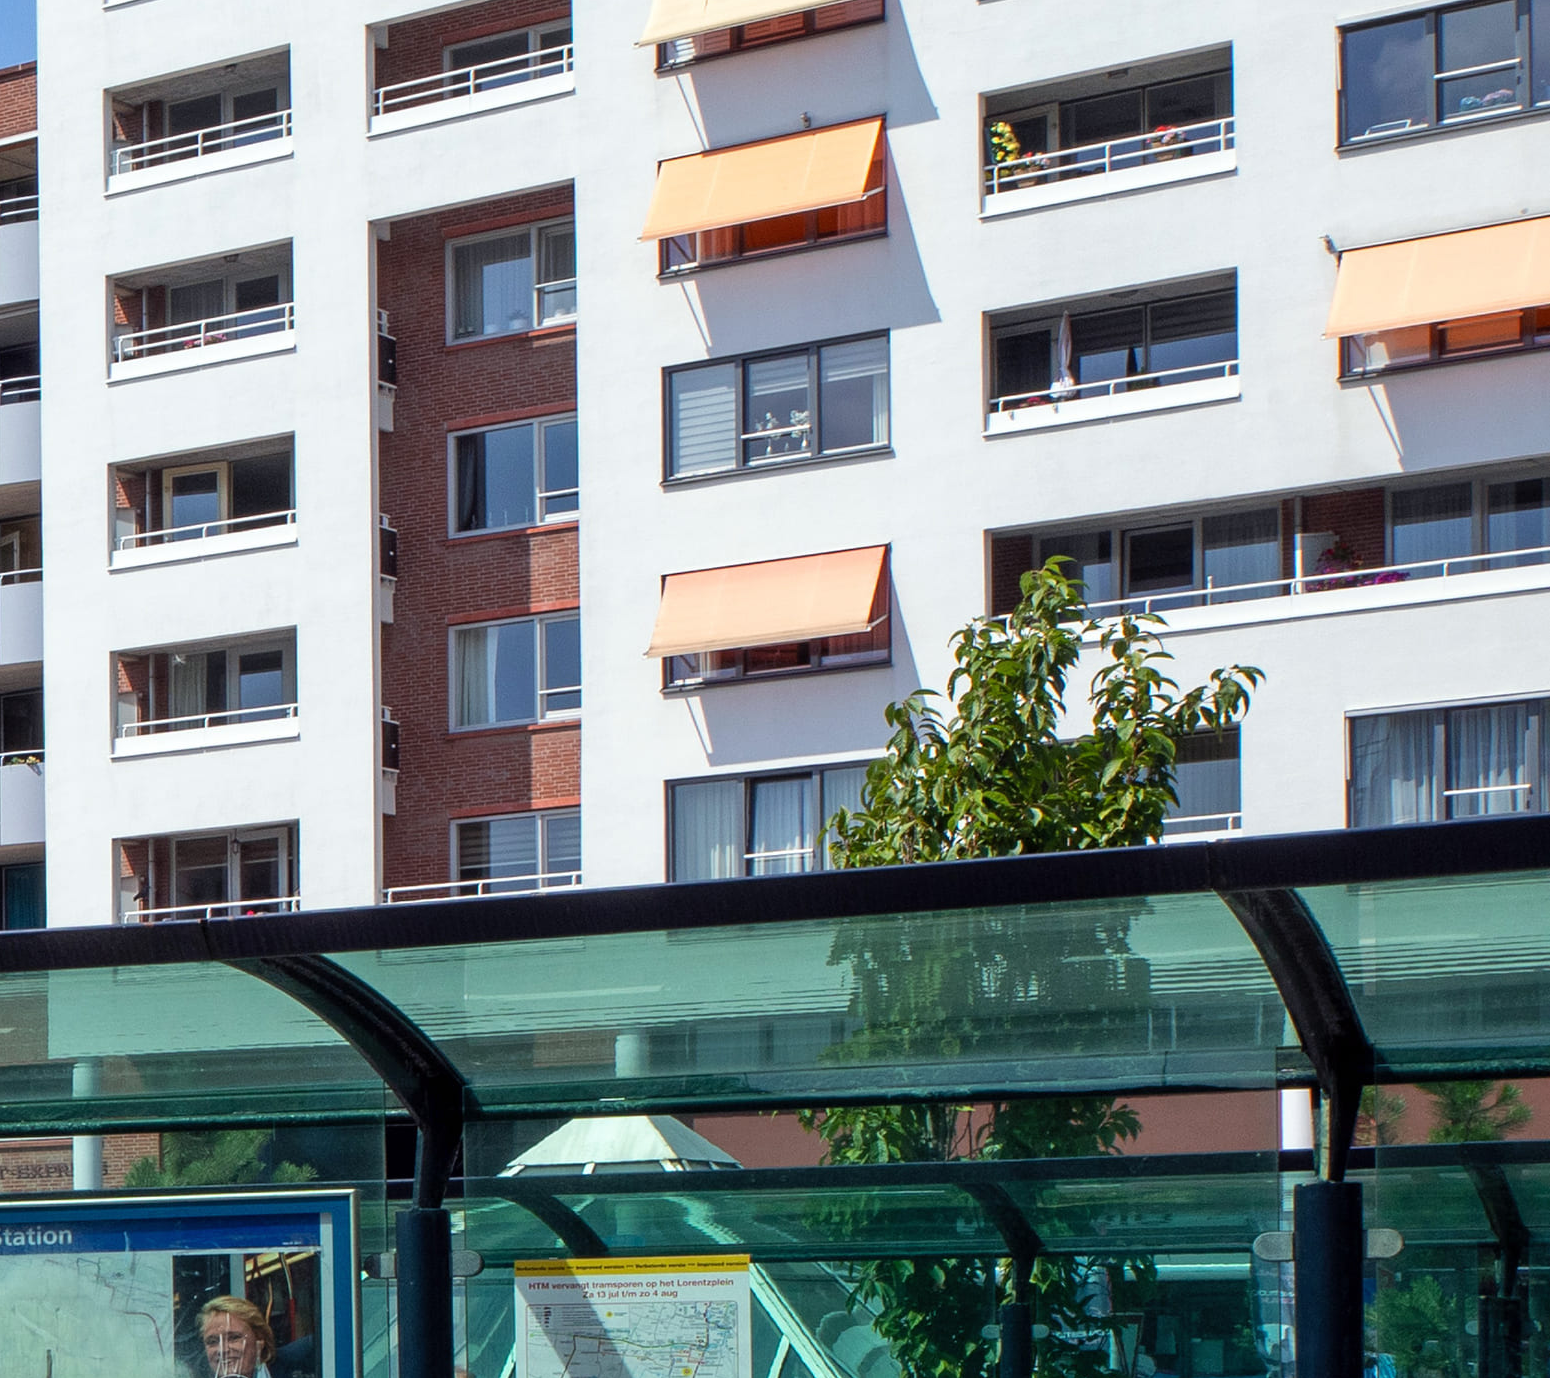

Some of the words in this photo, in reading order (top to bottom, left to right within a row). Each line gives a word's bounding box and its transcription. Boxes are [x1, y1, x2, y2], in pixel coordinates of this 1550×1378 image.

[528, 1282, 550, 1290] HTM
[551, 1282, 589, 1291] vervangt
[592, 1281, 643, 1290] tramsporen
[645, 1281, 658, 1290] op
[659, 1279, 675, 1287] het
[677, 1277, 734, 1288] Lorentzplein
[582, 1290, 594, 1299] Za
[596, 1290, 606, 1298] 13
[608, 1290, 619, 1300] jul
[652, 1289, 658, 1297] 4
[660, 1290, 678, 1299] aug
